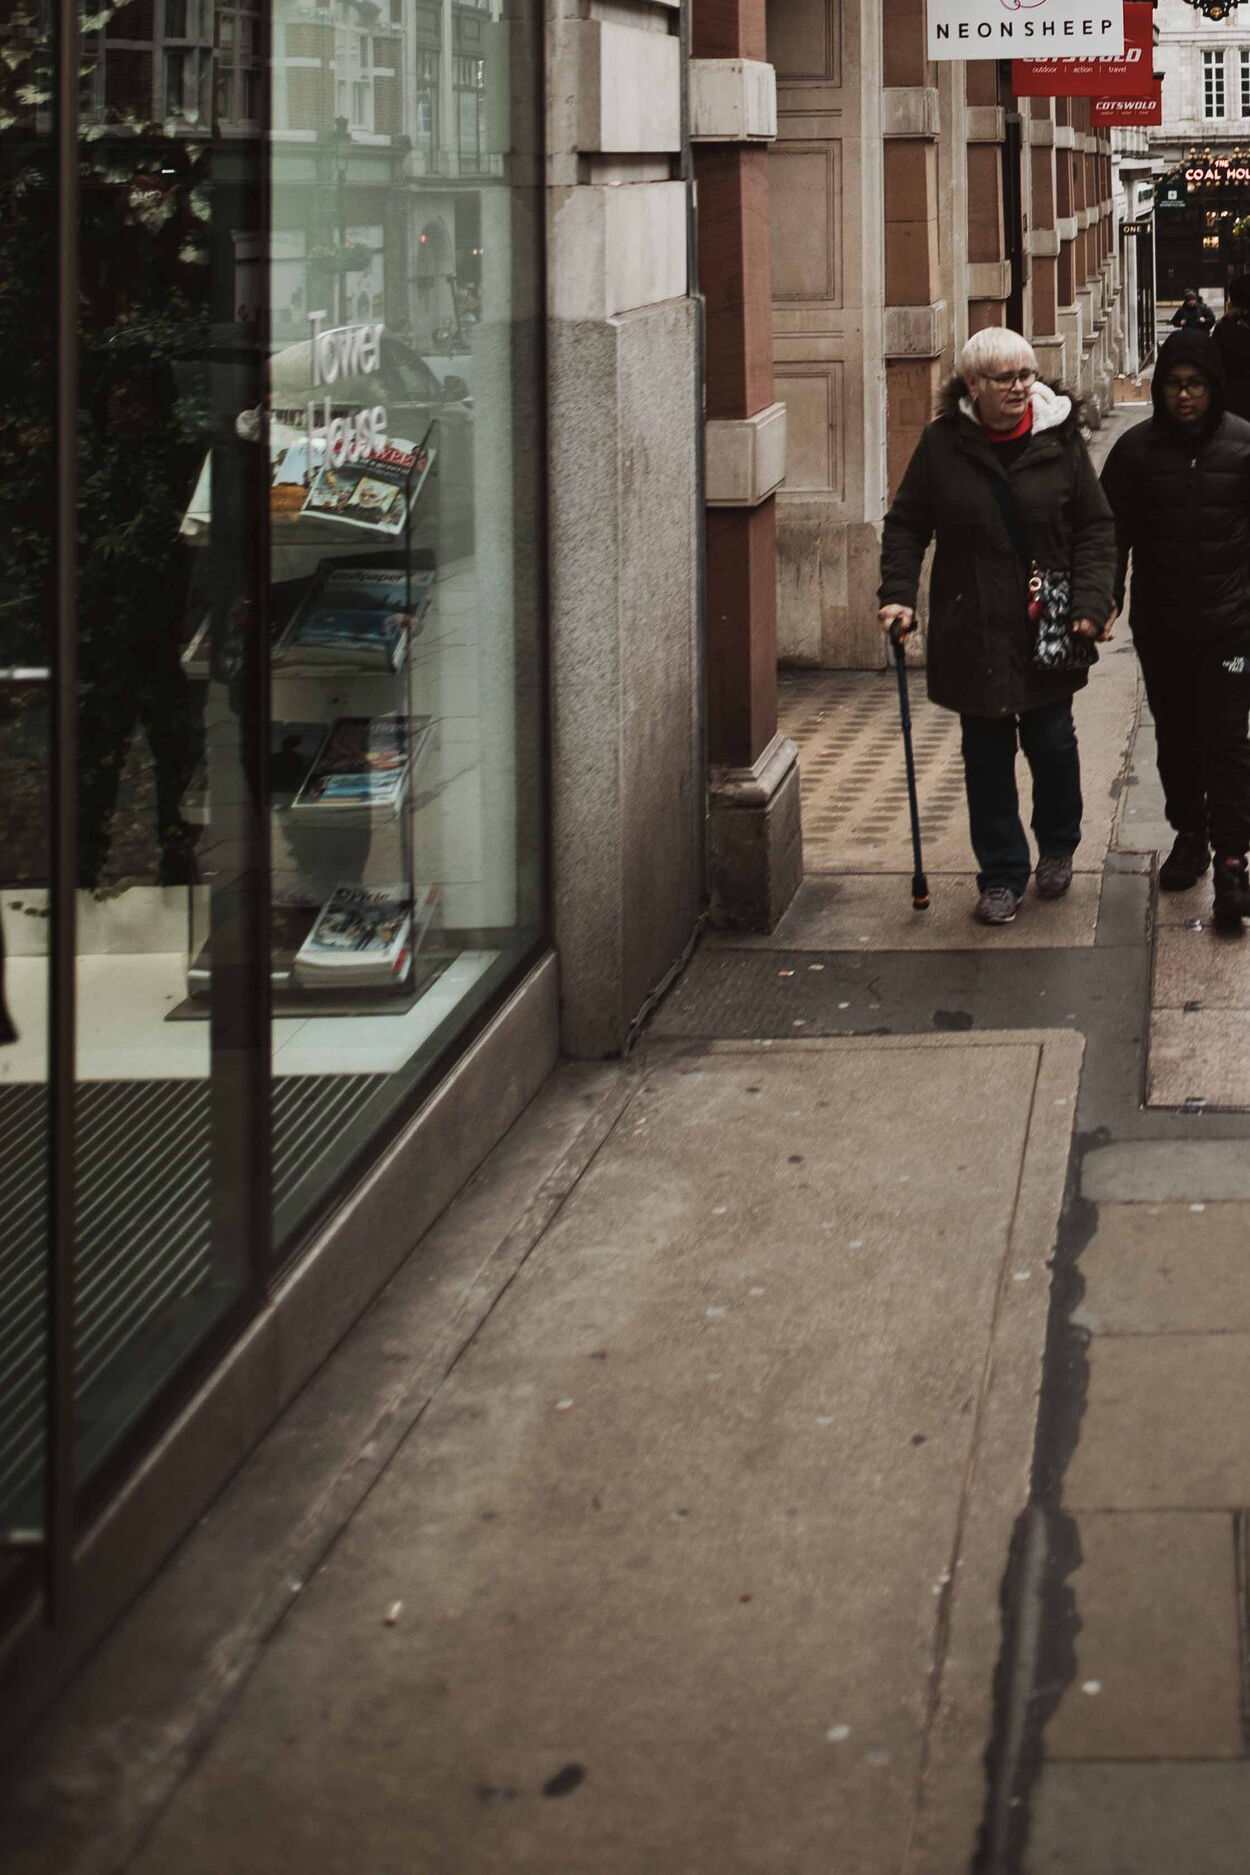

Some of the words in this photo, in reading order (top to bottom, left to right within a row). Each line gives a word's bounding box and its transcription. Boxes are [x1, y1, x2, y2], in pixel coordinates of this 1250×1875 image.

[936, 22, 1013, 39] NEON
[1024, 20, 1112, 37] SHEEP
[1032, 65, 1058, 73] outdoor
[1073, 65, 1094, 73] action
[1108, 65, 1127, 73] travel
[1095, 101, 1157, 110] COTSWOLD
[1214, 159, 1229, 168] THE
[1185, 169, 1221, 180] COAL
